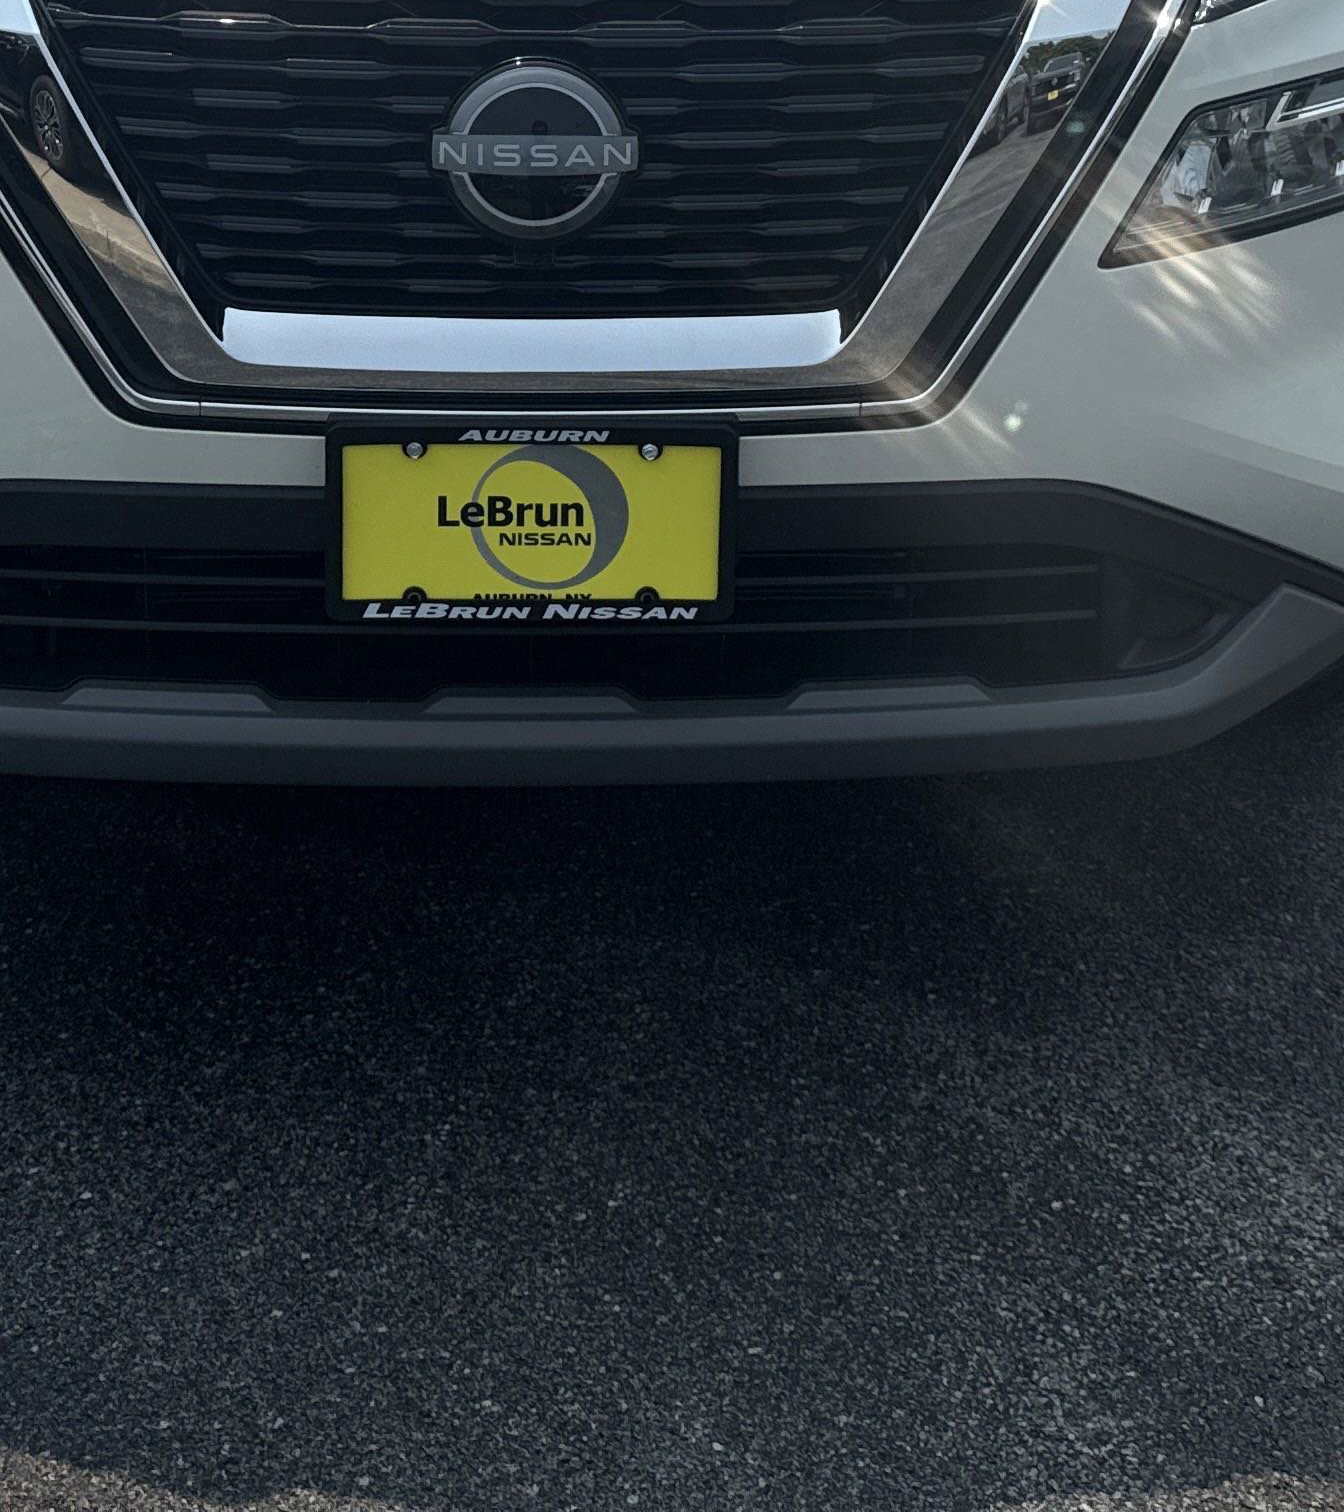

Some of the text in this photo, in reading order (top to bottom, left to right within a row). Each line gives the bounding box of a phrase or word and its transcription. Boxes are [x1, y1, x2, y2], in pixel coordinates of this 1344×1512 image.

[438, 141, 632, 168] NISSAN
[458, 429, 610, 442] AUBURN
[437, 495, 584, 528] LeBrun
[498, 532, 592, 547] NISSAN
